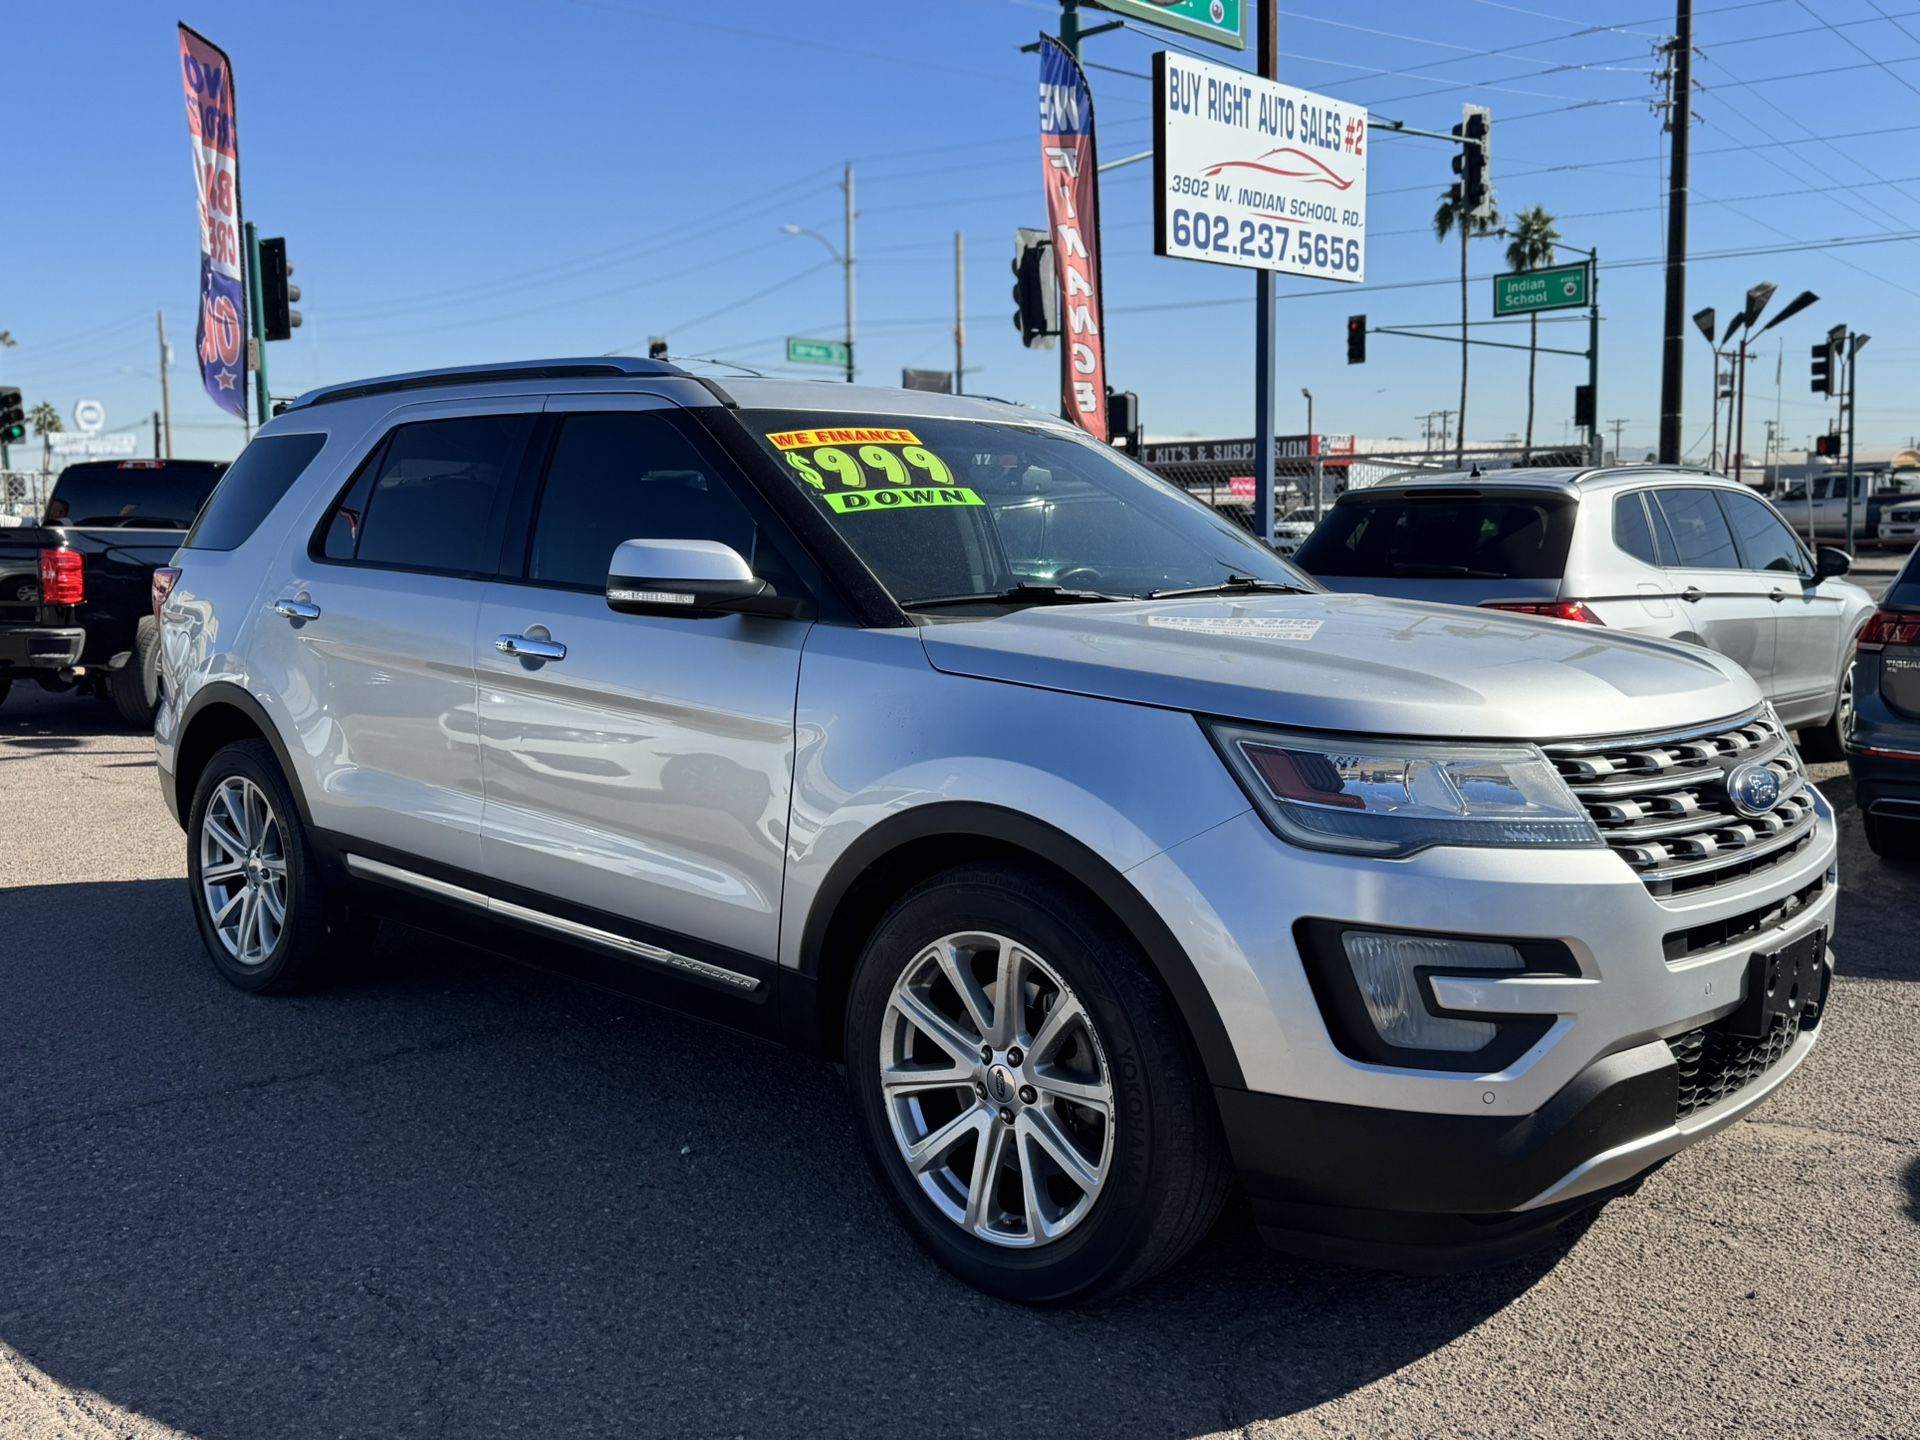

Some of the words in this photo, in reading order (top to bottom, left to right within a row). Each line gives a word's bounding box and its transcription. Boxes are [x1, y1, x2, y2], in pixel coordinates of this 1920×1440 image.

[1169, 67, 1202, 115] BUY
[1207, 78, 1252, 130] RIGHT
[1258, 92, 1295, 140] AUTO
[1300, 103, 1342, 152] SALES
[1344, 116, 1364, 156] #2
[1172, 175, 1209, 198] 3902
[1215, 183, 1233, 203] W.
[1238, 188, 1286, 214] INDIAN
[1290, 198, 1338, 224] SCHOOL
[1172, 207, 1360, 273] 602.237.5656
[1505, 291, 1548, 307] School
[1507, 279, 1546, 293] Indian
[771, 431, 811, 447] WE
[815, 429, 915, 444] FINANCE
[784, 445, 955, 491] $999
[841, 488, 967, 509] DOWN
[671, 958, 752, 988] EXPLORER
